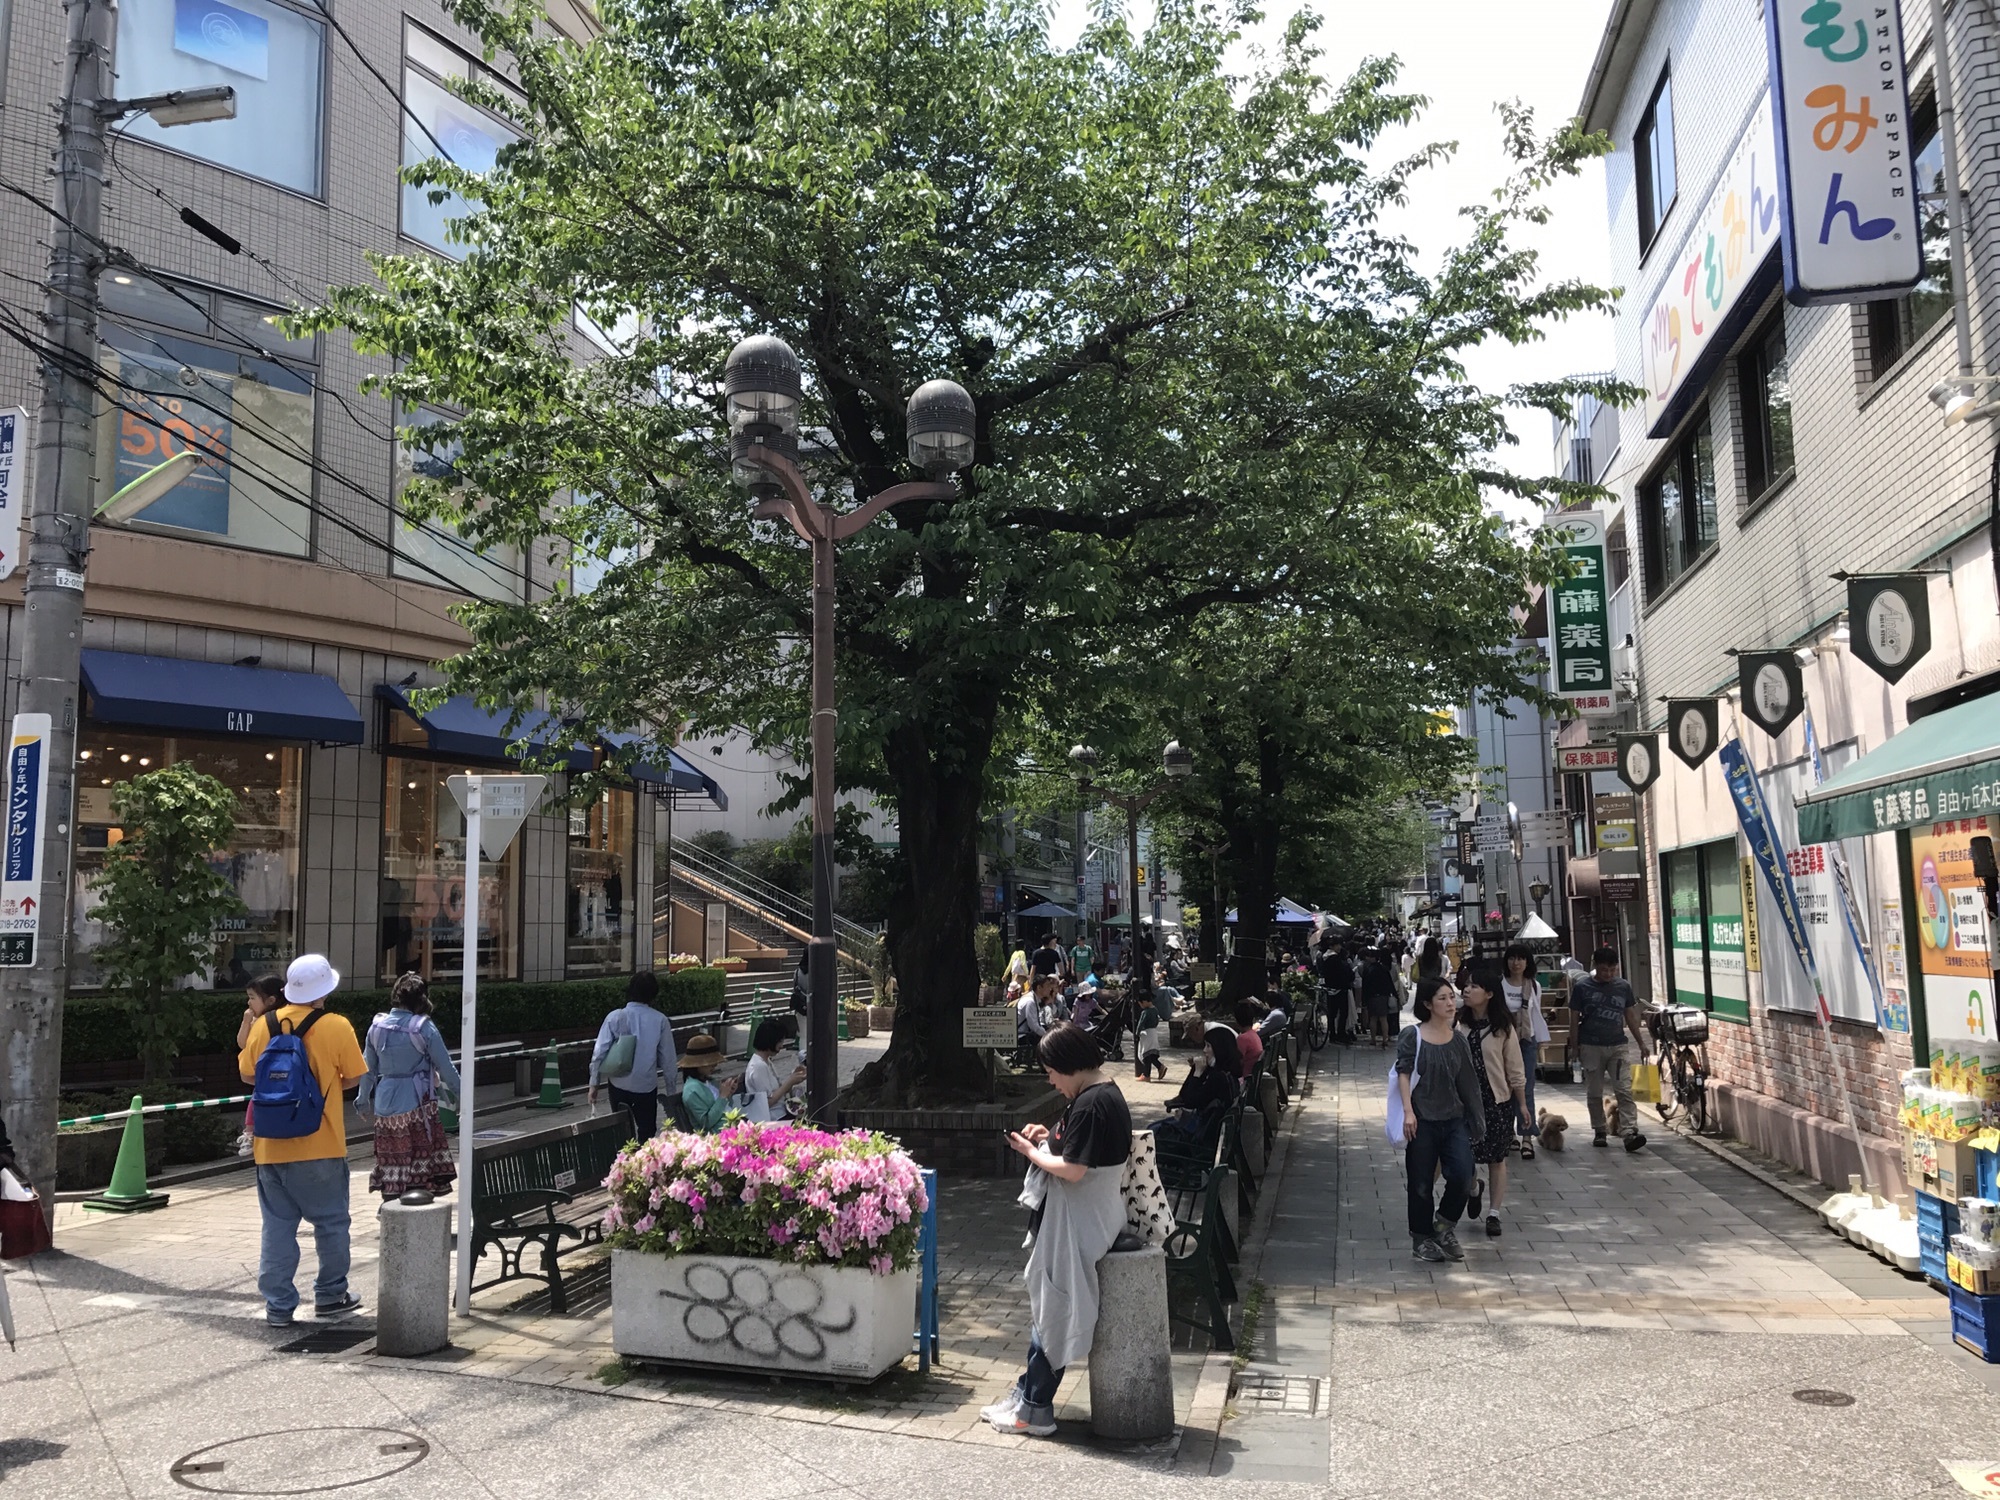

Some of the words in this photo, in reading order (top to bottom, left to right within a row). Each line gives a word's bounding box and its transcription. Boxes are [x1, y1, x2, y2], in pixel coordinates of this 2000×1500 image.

[1736, 109, 1764, 166] SPACE
[1885, 113, 1904, 198] SPACE
[1684, 151, 1775, 336] てもみん
[122, 388, 150, 403] UP
[155, 396, 183, 414] TO
[227, 711, 254, 732] GAP
[1872, 788, 1931, 828] 安藤薬品
